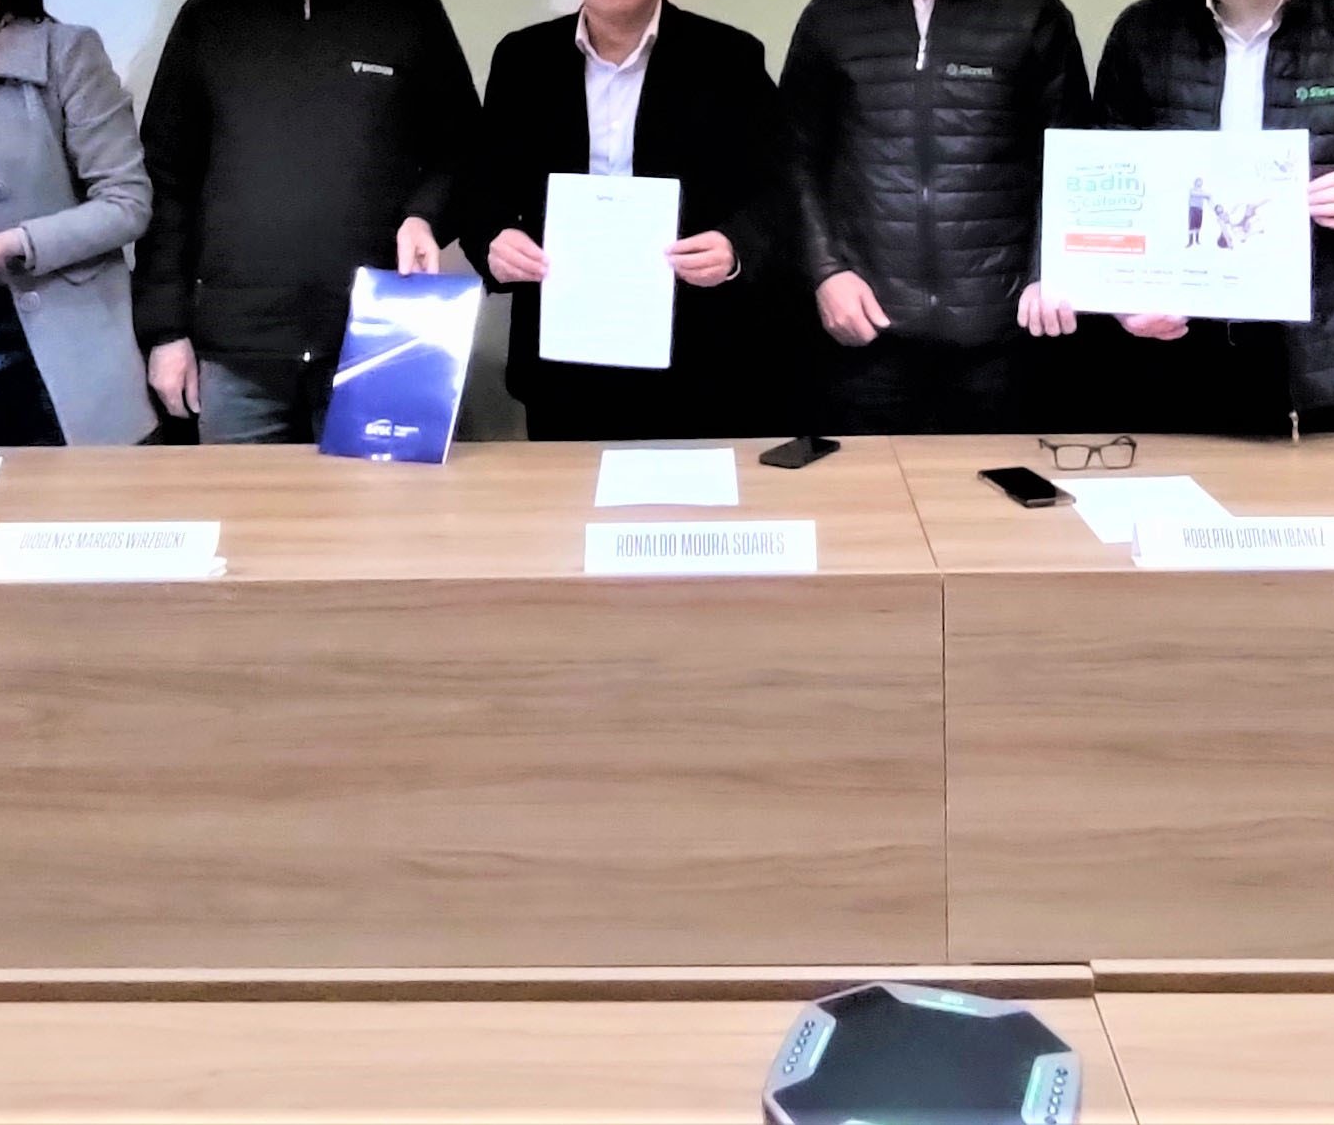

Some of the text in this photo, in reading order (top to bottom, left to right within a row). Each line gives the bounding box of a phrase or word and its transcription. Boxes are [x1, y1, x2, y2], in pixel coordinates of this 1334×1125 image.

[1067, 172, 1141, 192] Badin
[75, 531, 123, 550] MARCOS
[616, 531, 786, 557] RONALDO MOURA SOARES
[1182, 528, 1234, 549] ROBERTO
